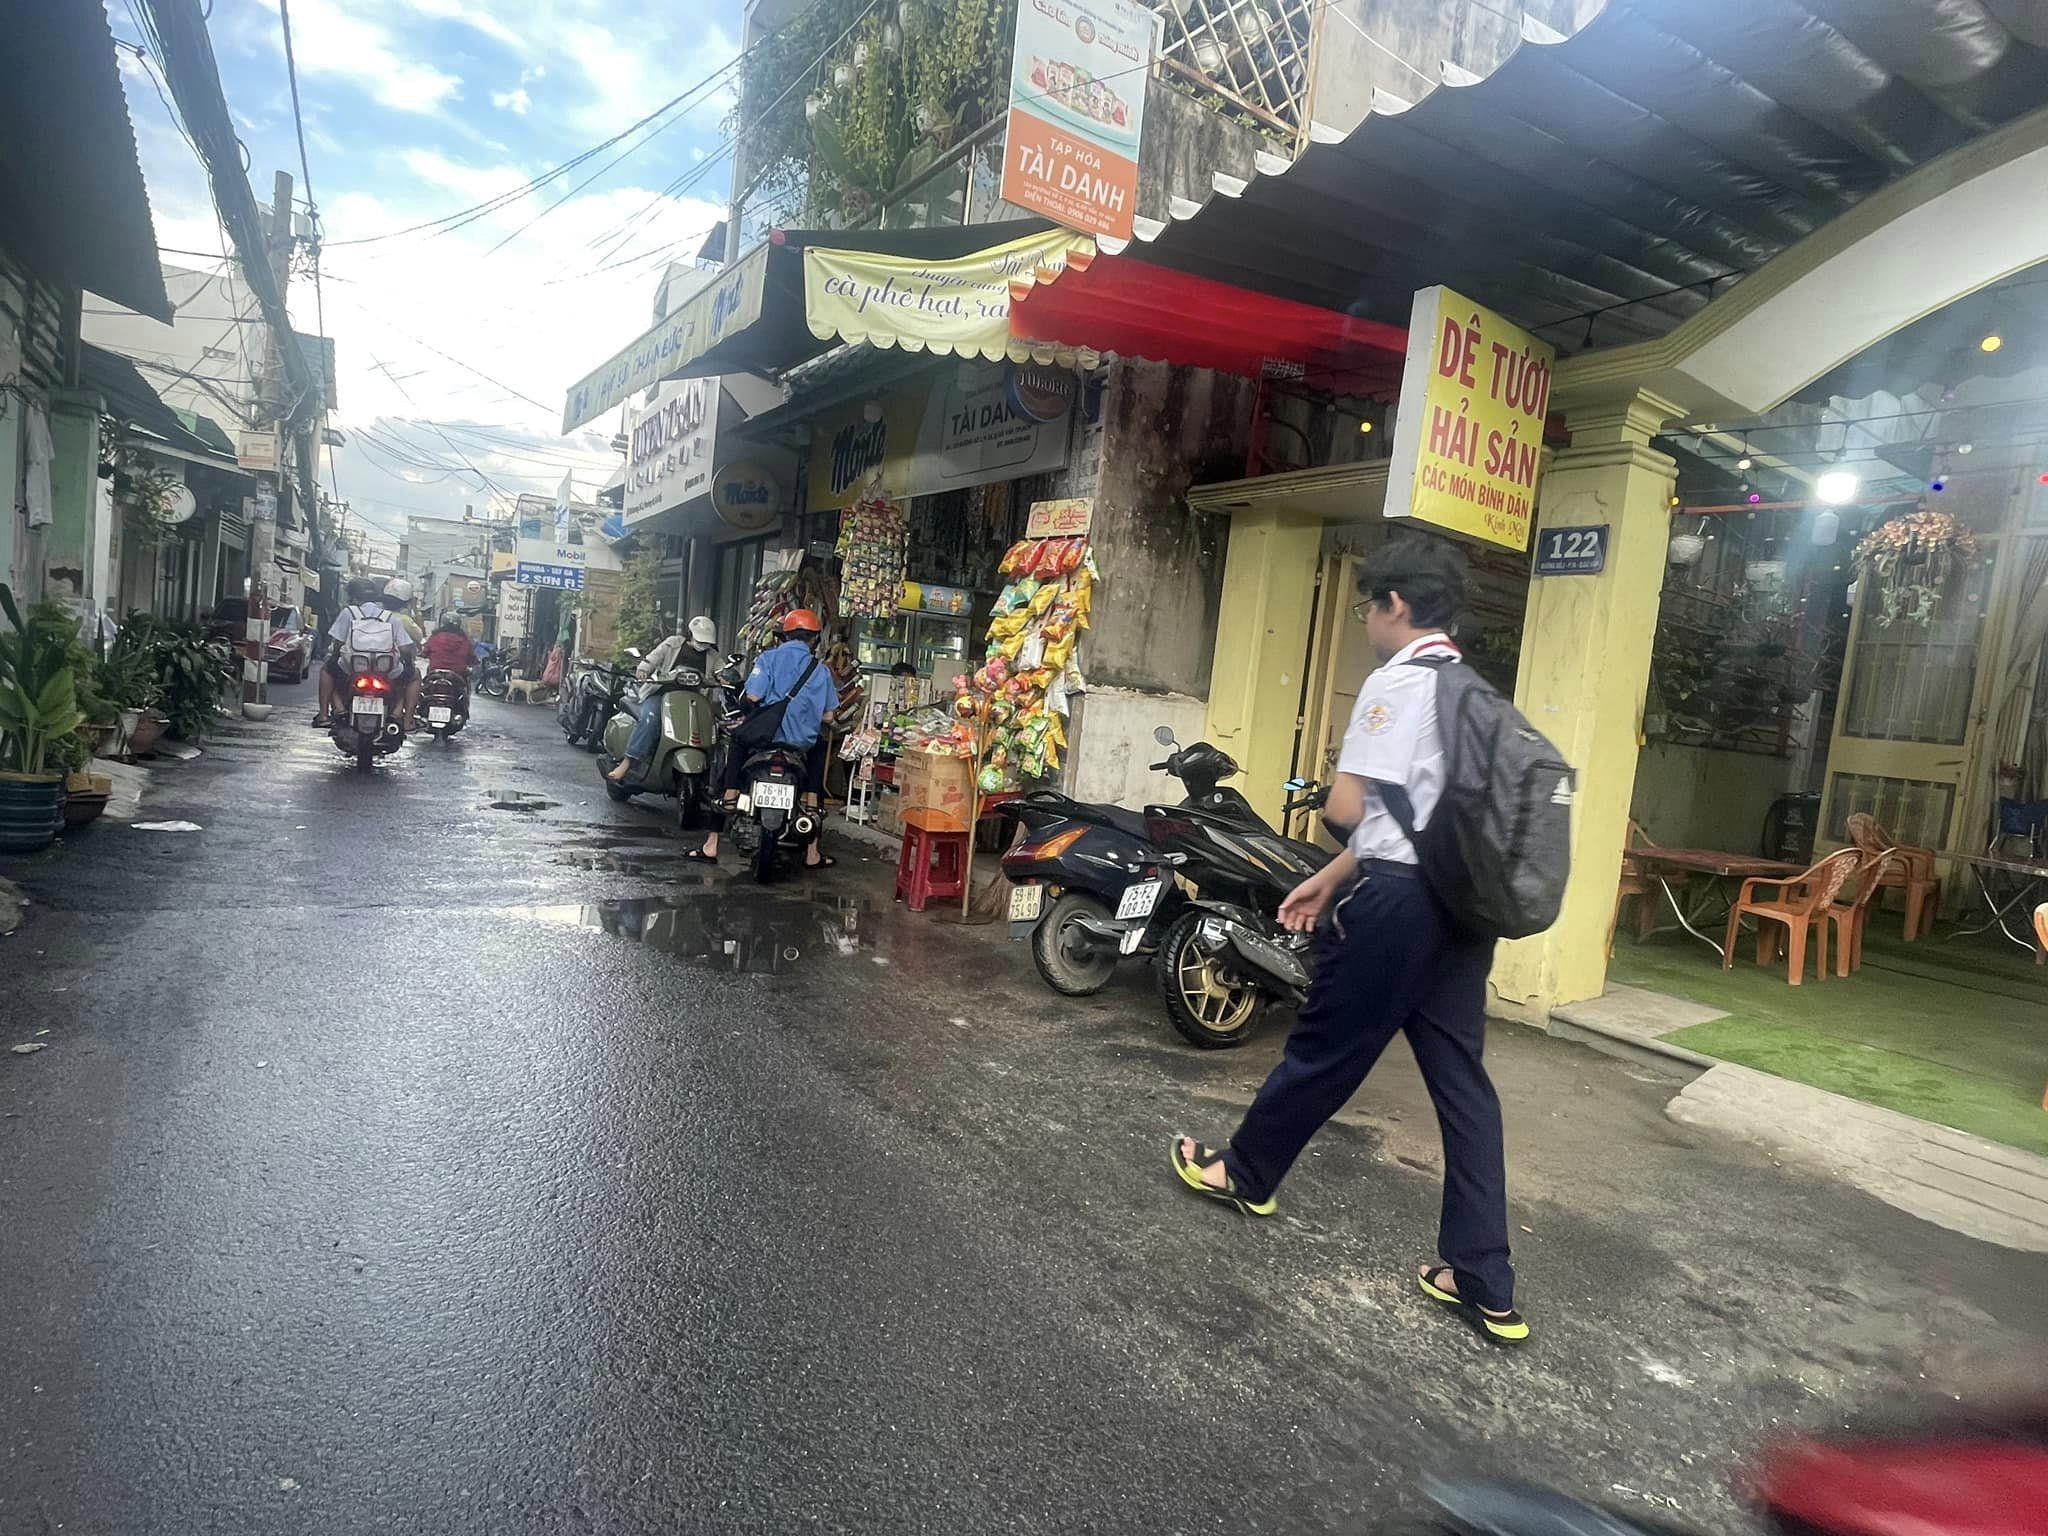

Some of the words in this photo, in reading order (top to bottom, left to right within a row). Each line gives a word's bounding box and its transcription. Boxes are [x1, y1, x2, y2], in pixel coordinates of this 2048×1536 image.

[1050, 137, 1073, 156] TẠP
[1019, 143, 1055, 182] TÀI
[1060, 164, 1125, 213] DANH
[824, 274, 857, 297] cà
[858, 276, 914, 313] phê
[918, 284, 969, 320] hạt,
[1438, 313, 1482, 389] DÊ
[1490, 341, 1550, 421] TƯƠI
[951, 404, 977, 436] TÀI
[1429, 397, 1480, 467] HẢI
[1484, 419, 1537, 489] SẢN
[1421, 462, 1447, 492] CÁC
[1448, 472, 1476, 502] MÓN
[1506, 492, 1529, 520] DÂN
[557, 549, 586, 561] Mobil
[1550, 531, 1598, 558] 122
[520, 574, 530, 583] 2
